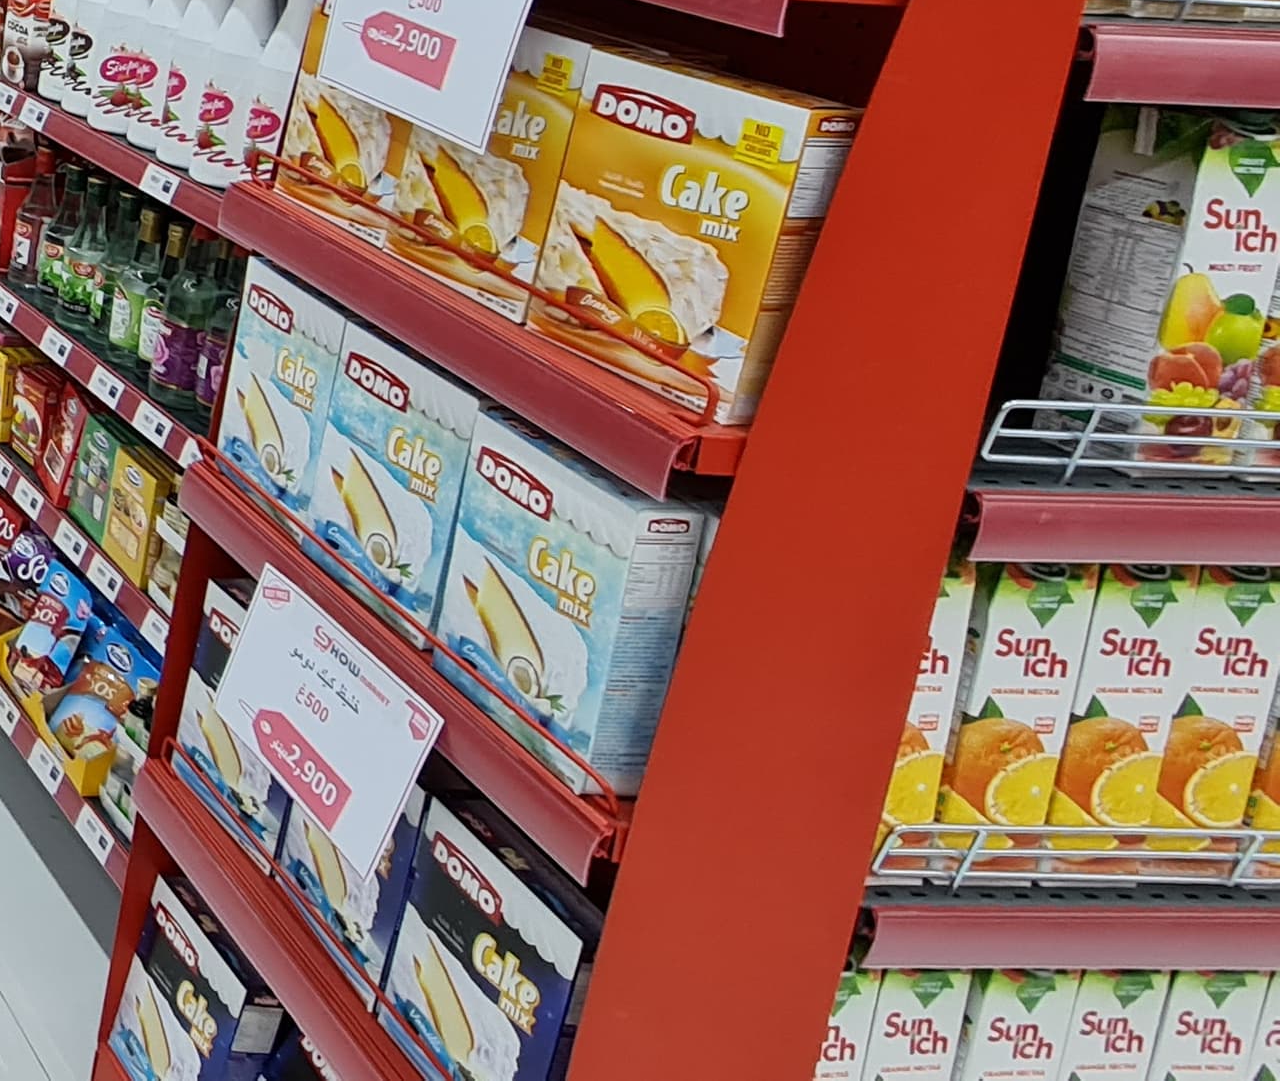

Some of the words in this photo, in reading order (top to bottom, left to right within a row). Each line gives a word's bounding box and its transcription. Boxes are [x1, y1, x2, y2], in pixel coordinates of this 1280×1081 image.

[7, 20, 29, 36] COCOA
[391, 23, 442, 60] 2,900
[598, 96, 689, 141] DOMO
[755, 123, 771, 138] NO
[820, 119, 856, 134] DOMO
[510, 141, 540, 160] mix
[659, 164, 750, 220] Cake
[1204, 198, 1262, 230] Sun
[698, 217, 741, 242] mix
[1235, 227, 1277, 254] ich
[248, 290, 292, 331] DOMO
[579, 292, 621, 323] Orange
[275, 347, 318, 393] Cake
[347, 358, 407, 410] DOMO
[293, 391, 314, 411] mix
[386, 426, 441, 483] Cake
[410, 478, 437, 503] mix
[479, 452, 549, 516] DOMO
[648, 521, 689, 534] DOMO
[527, 536, 597, 603] Cake
[557, 595, 592, 627] mix
[313, 624, 361, 678] SHOW
[995, 628, 1051, 659] Sun
[1099, 628, 1158, 659] Sun
[1194, 627, 1253, 657] Sun
[1023, 654, 1068, 679] ich
[1126, 654, 1172, 678] ich
[1223, 654, 1269, 678] ich
[288, 742, 338, 807] 2,900
[435, 840, 498, 915] DOMO
[155, 910, 197, 967] DOMO
[472, 932, 541, 1008] Cake
[176, 980, 218, 1043] Cake
[500, 998, 538, 1030] mix
[883, 1011, 933, 1040] Sun
[1080, 1010, 1131, 1037] Sun
[1175, 1010, 1228, 1037] Sun
[909, 1031, 948, 1056] ich
[987, 1016, 1039, 1044] Sun
[1104, 1030, 1143, 1055] ich
[1200, 1030, 1242, 1056] ich
[1012, 1038, 1053, 1061] ich
